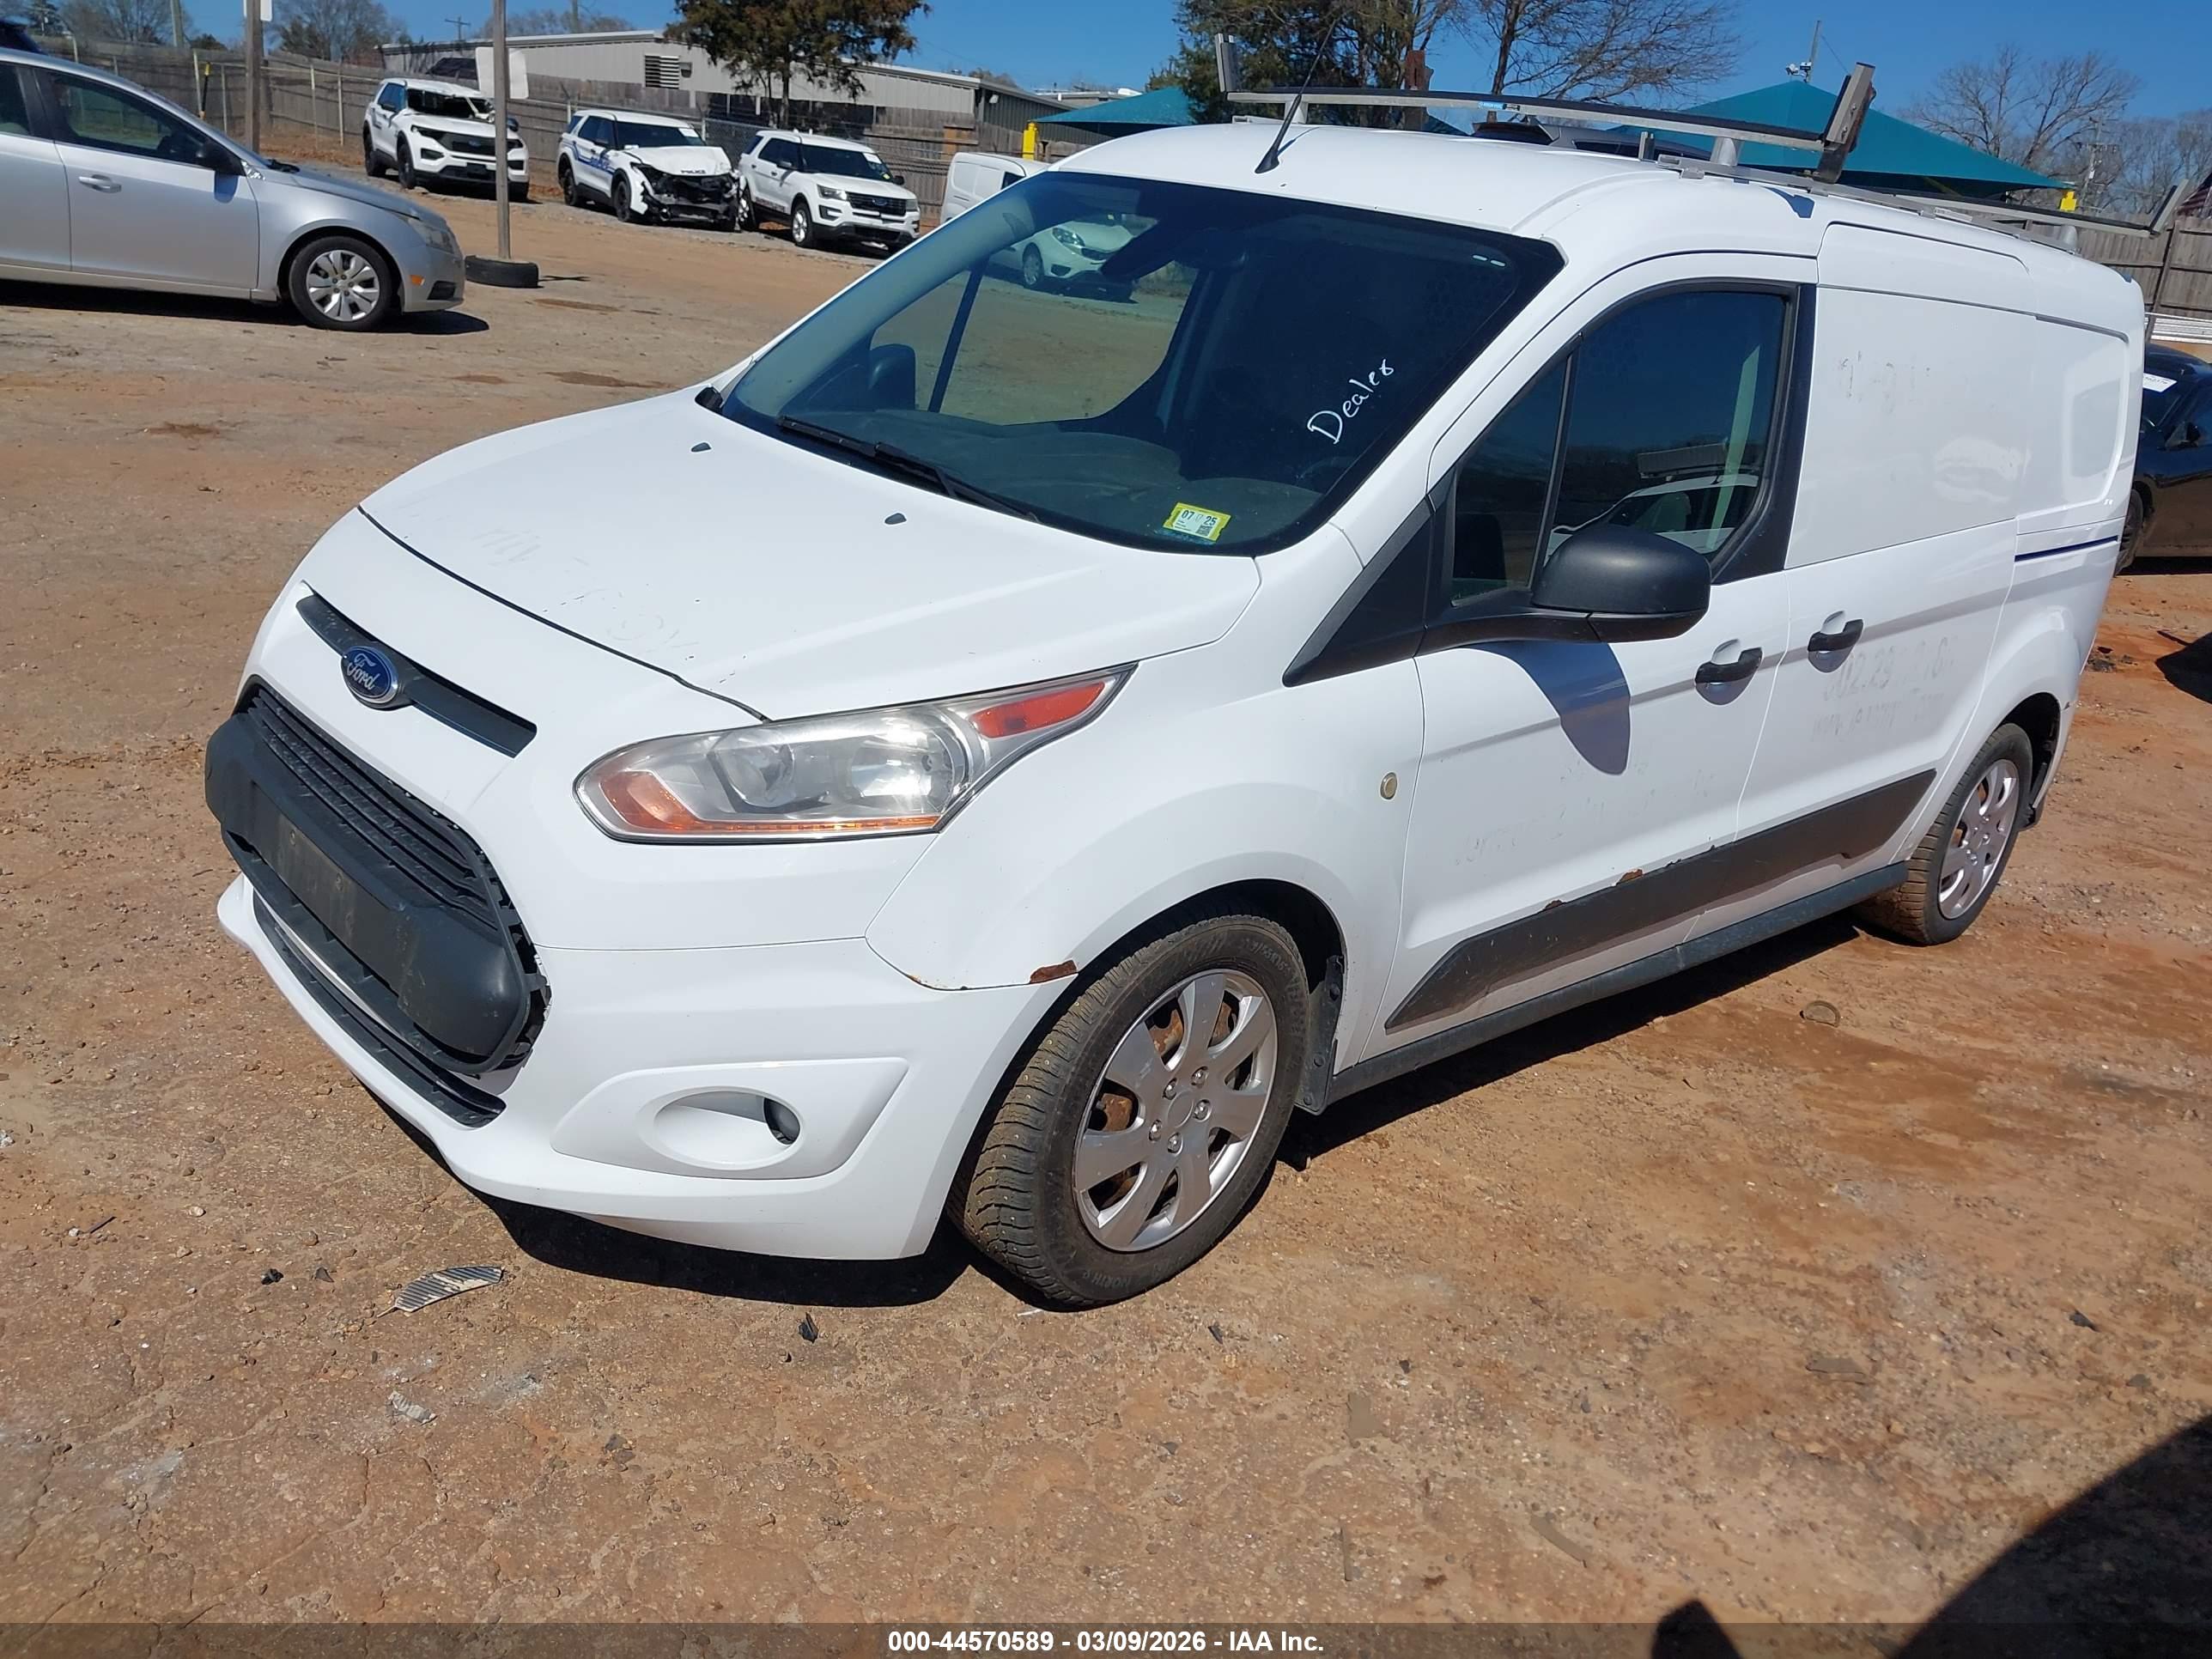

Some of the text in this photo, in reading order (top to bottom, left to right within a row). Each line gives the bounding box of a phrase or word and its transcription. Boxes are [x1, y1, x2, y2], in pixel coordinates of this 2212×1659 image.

[1307, 358, 1395, 445] Dealer
[1181, 509, 1194, 520] 07
[1203, 515, 1218, 526] 25
[346, 653, 380, 690] Ford
